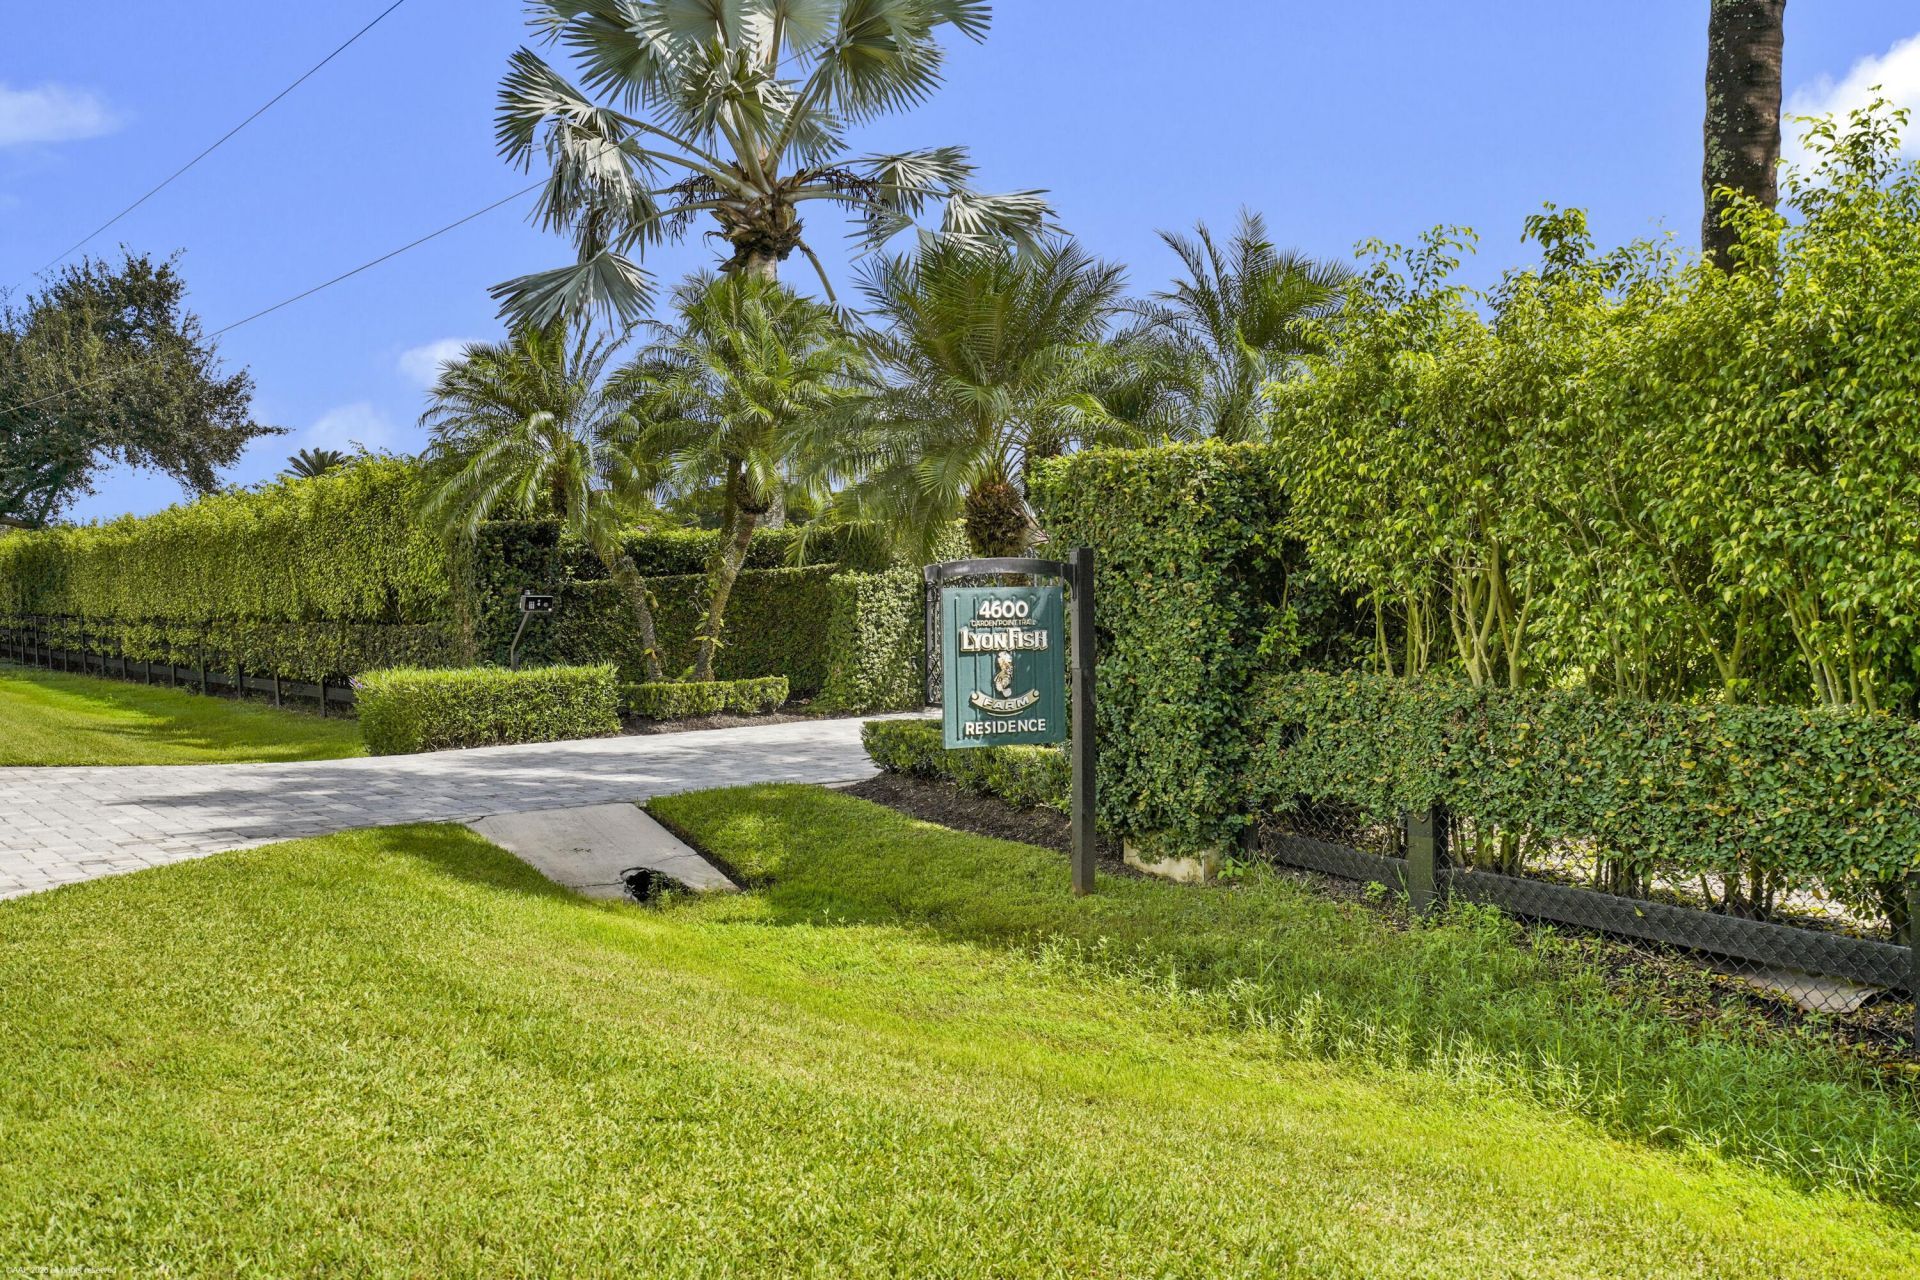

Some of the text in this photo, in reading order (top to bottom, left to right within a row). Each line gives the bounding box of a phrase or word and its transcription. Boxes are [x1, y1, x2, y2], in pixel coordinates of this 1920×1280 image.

[978, 600, 1029, 618] 4600
[983, 697, 1030, 710] FARM
[965, 719, 1047, 735] RESIDENCE
